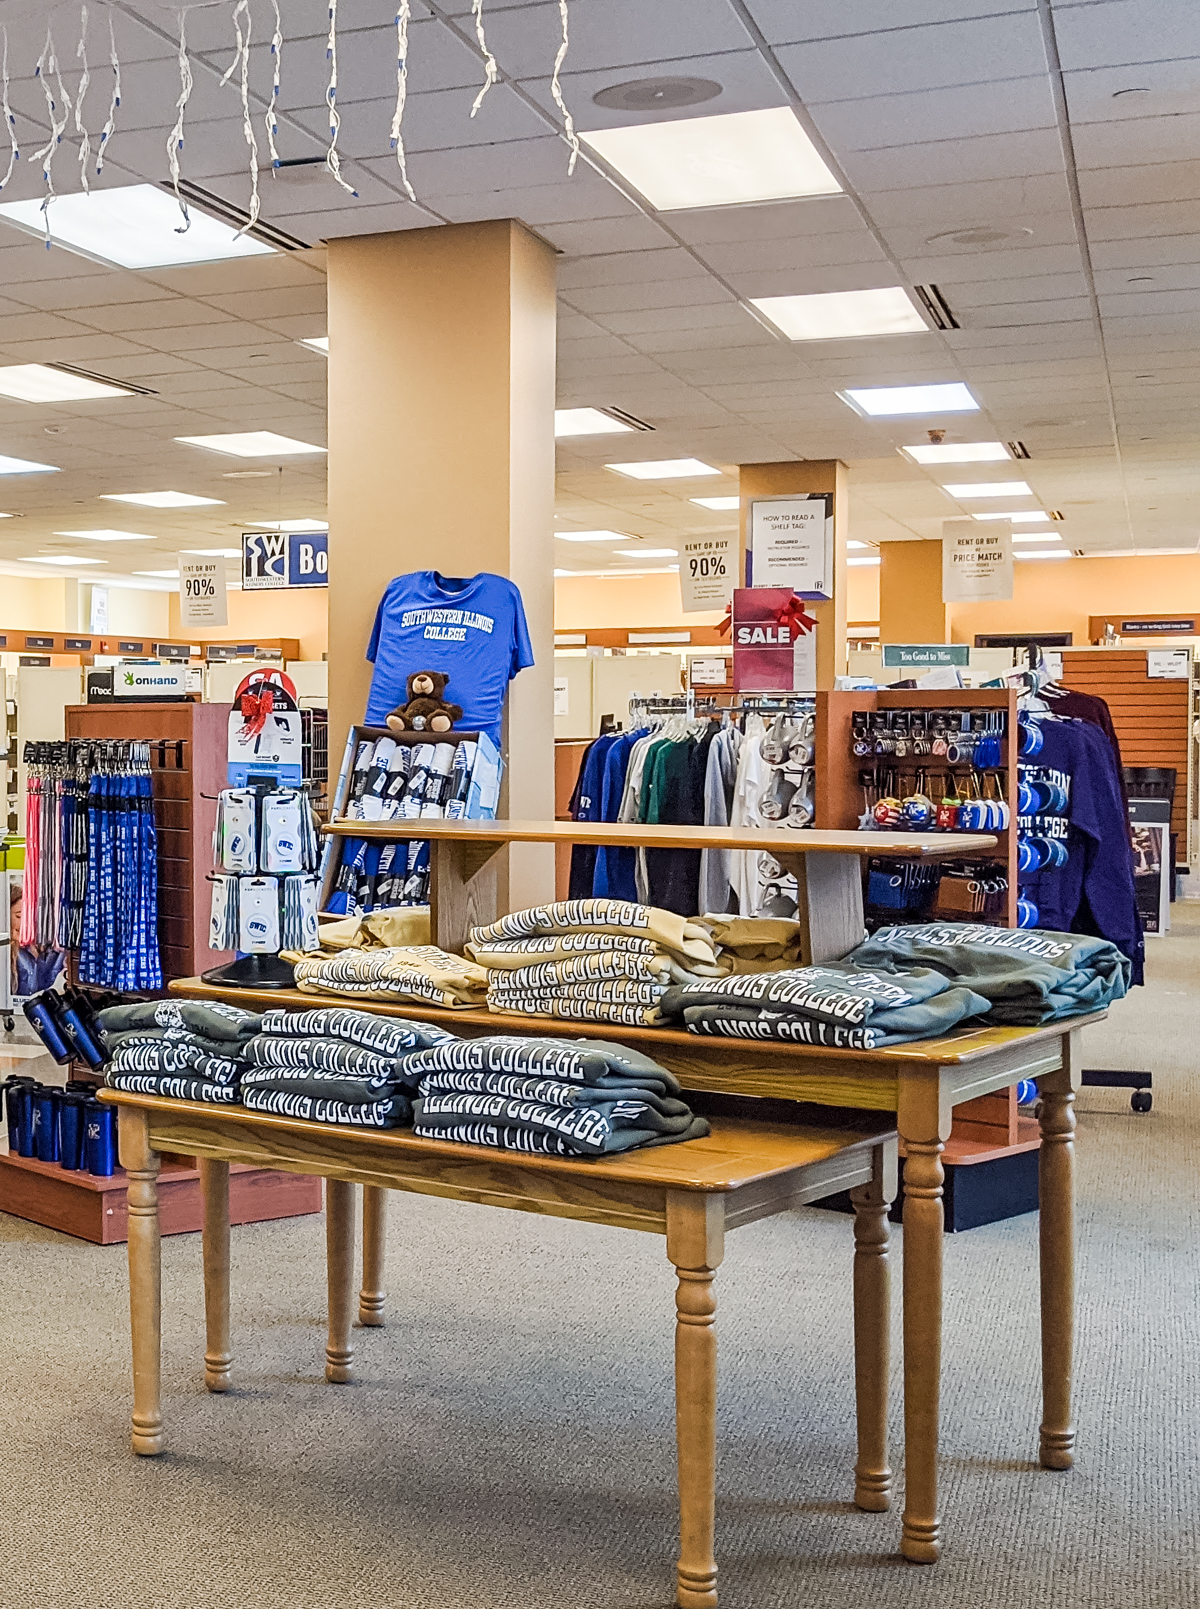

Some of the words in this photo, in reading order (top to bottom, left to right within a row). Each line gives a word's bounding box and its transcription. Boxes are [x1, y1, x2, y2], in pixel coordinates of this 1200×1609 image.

[685, 543, 702, 551] RENT
[704, 542, 713, 550] OR
[715, 541, 728, 549] BUY
[957, 538, 974, 546] RENT
[986, 537, 999, 545] BUY
[689, 555, 726, 577] 90%
[953, 553, 976, 562] PRICE
[977, 552, 1003, 562] MATCH
[185, 578, 215, 596] 90%
[401, 608, 464, 628] SOUTHWESTERN
[461, 609, 495, 634] ILLINOIS
[423, 625, 467, 642] COLLEGE
[737, 626, 791, 645] SALE
[899, 651, 912, 661] Too
[911, 650, 930, 661] Good
[930, 652, 937, 661] to
[554, 898, 650, 929] COLLEGE
[560, 951, 654, 982] COLLEGE
[767, 976, 875, 1025] COLLEGE
[557, 998, 650, 1026] COLLEGE
[402, 1041, 483, 1076] ILLINOIS
[488, 1042, 585, 1080] COLLEGE
[422, 1093, 503, 1117] ILLINOIS
[506, 1100, 610, 1147] COLLEGE
